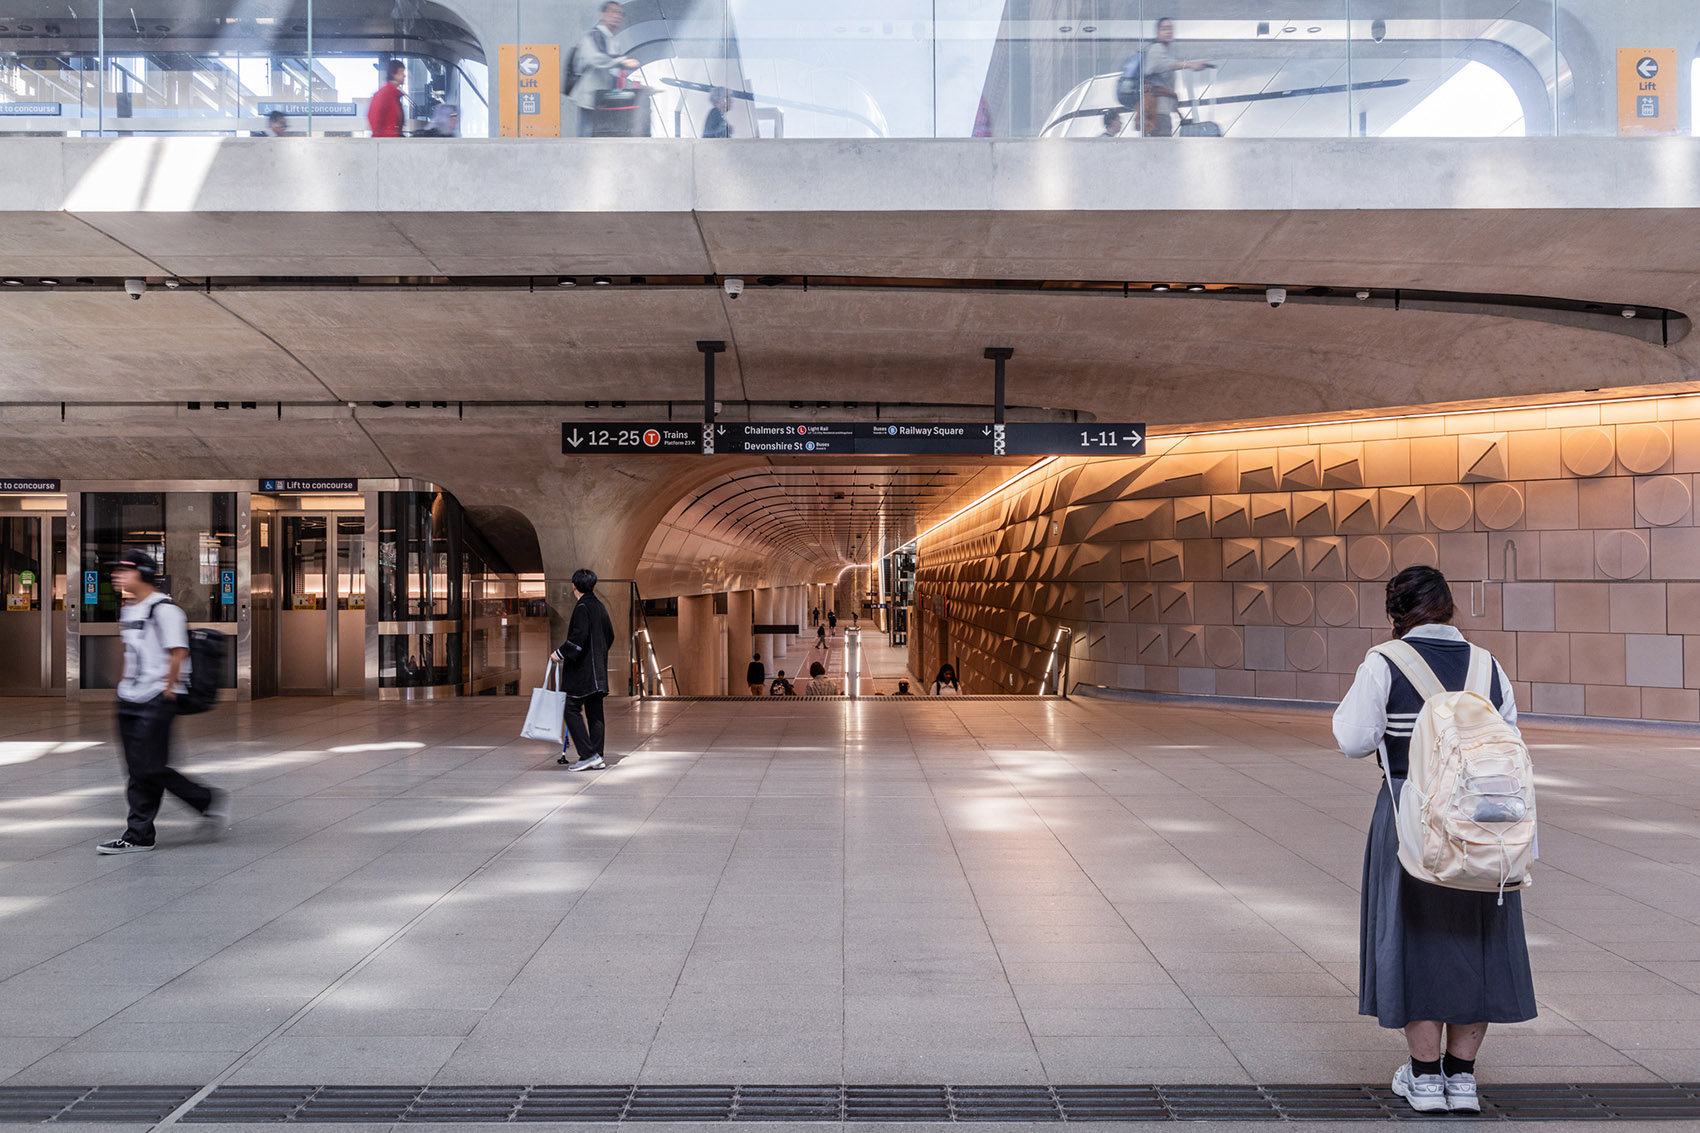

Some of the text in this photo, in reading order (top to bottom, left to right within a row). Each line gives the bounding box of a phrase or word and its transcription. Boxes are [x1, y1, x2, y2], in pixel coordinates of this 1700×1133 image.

[519, 79, 538, 88] Lift
[1639, 81, 1657, 91] Lift
[285, 105, 352, 113] Lift to concourse
[744, 426, 785, 435] Chalmers
[785, 426, 795, 435] St
[899, 426, 932, 436] Railway
[933, 426, 964, 436] Square
[588, 430, 640, 446] 12-25
[663, 430, 689, 439] Trains
[1080, 431, 1118, 446] 1-11
[744, 442, 793, 450] Devonshire
[794, 442, 804, 450] St
[286, 481, 301, 489] Lift
